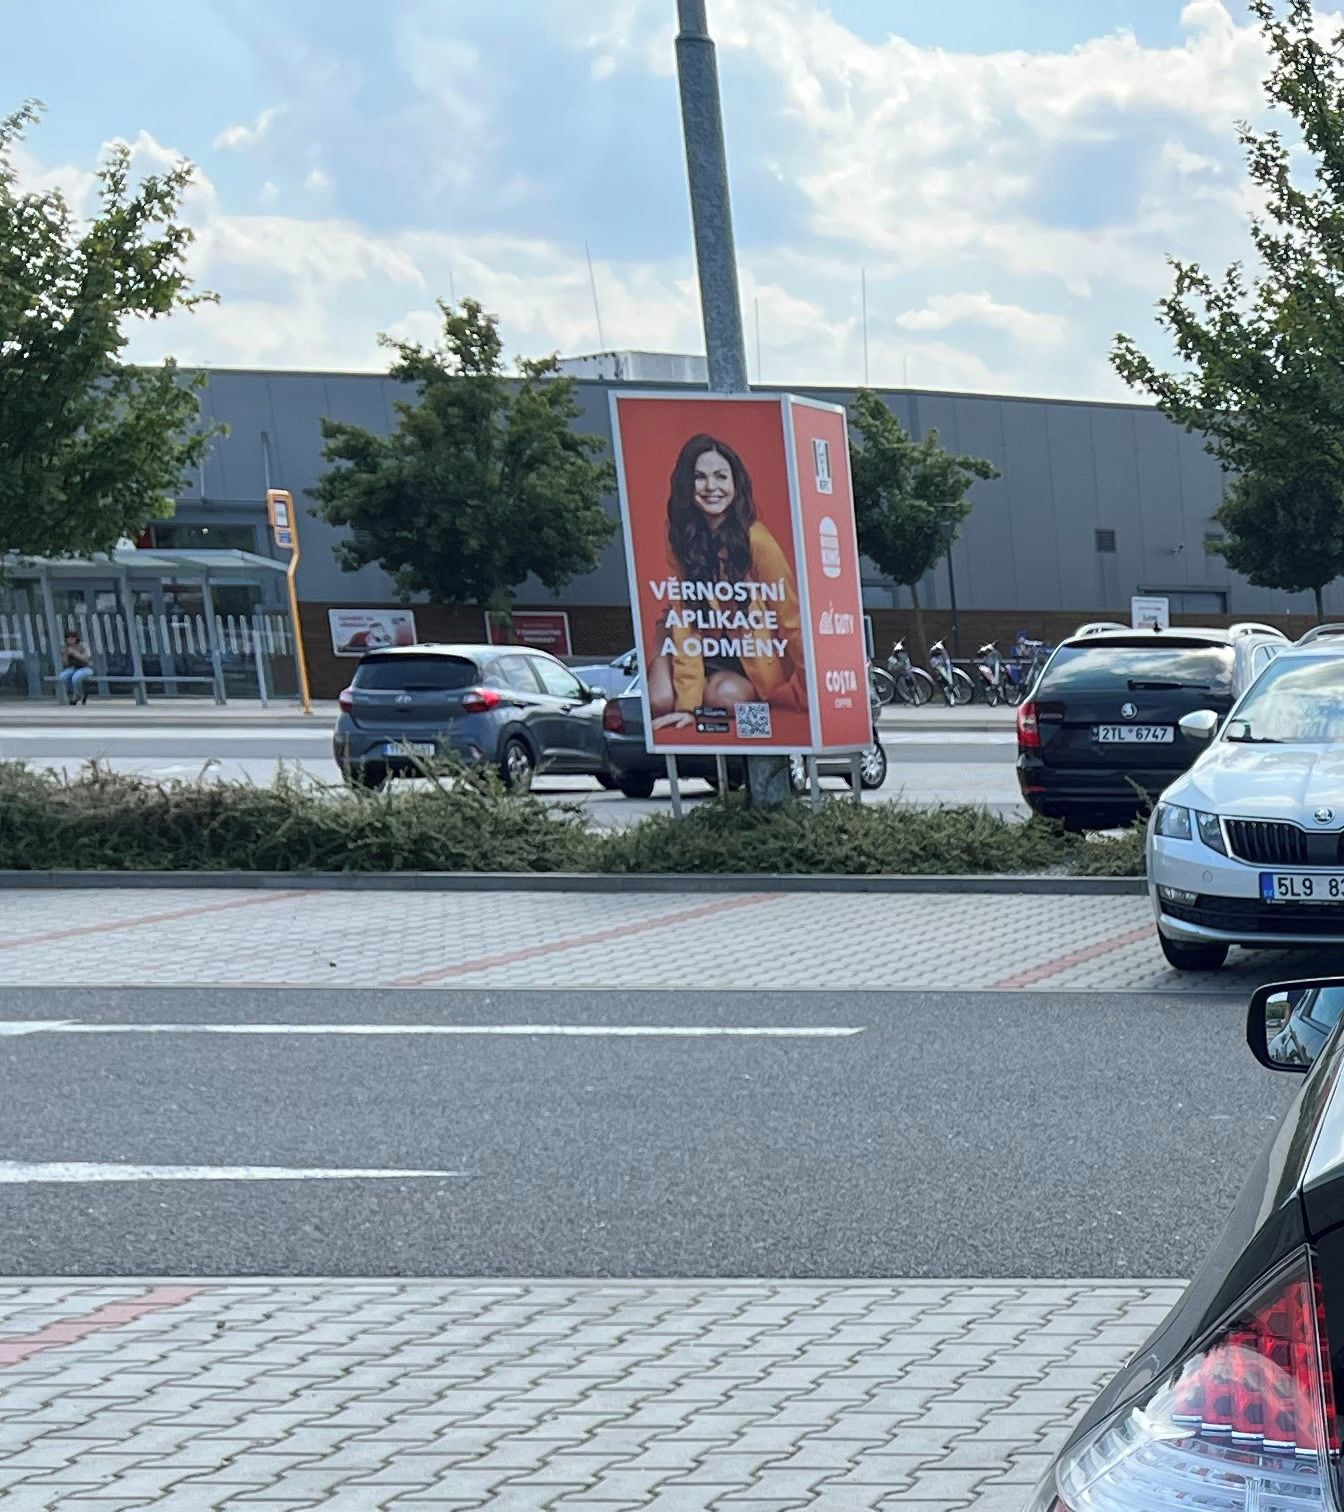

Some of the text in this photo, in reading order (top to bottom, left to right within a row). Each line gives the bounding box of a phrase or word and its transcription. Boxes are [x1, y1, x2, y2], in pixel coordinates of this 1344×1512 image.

[649, 576, 786, 601] VĚRNOSTNÍ
[665, 609, 778, 629] APLIKACE
[660, 633, 788, 657] A ODMĚNY
[825, 670, 858, 694] COSTA
[1102, 728, 1167, 741] 2TL 6747
[1278, 877, 1314, 896] 5L9
